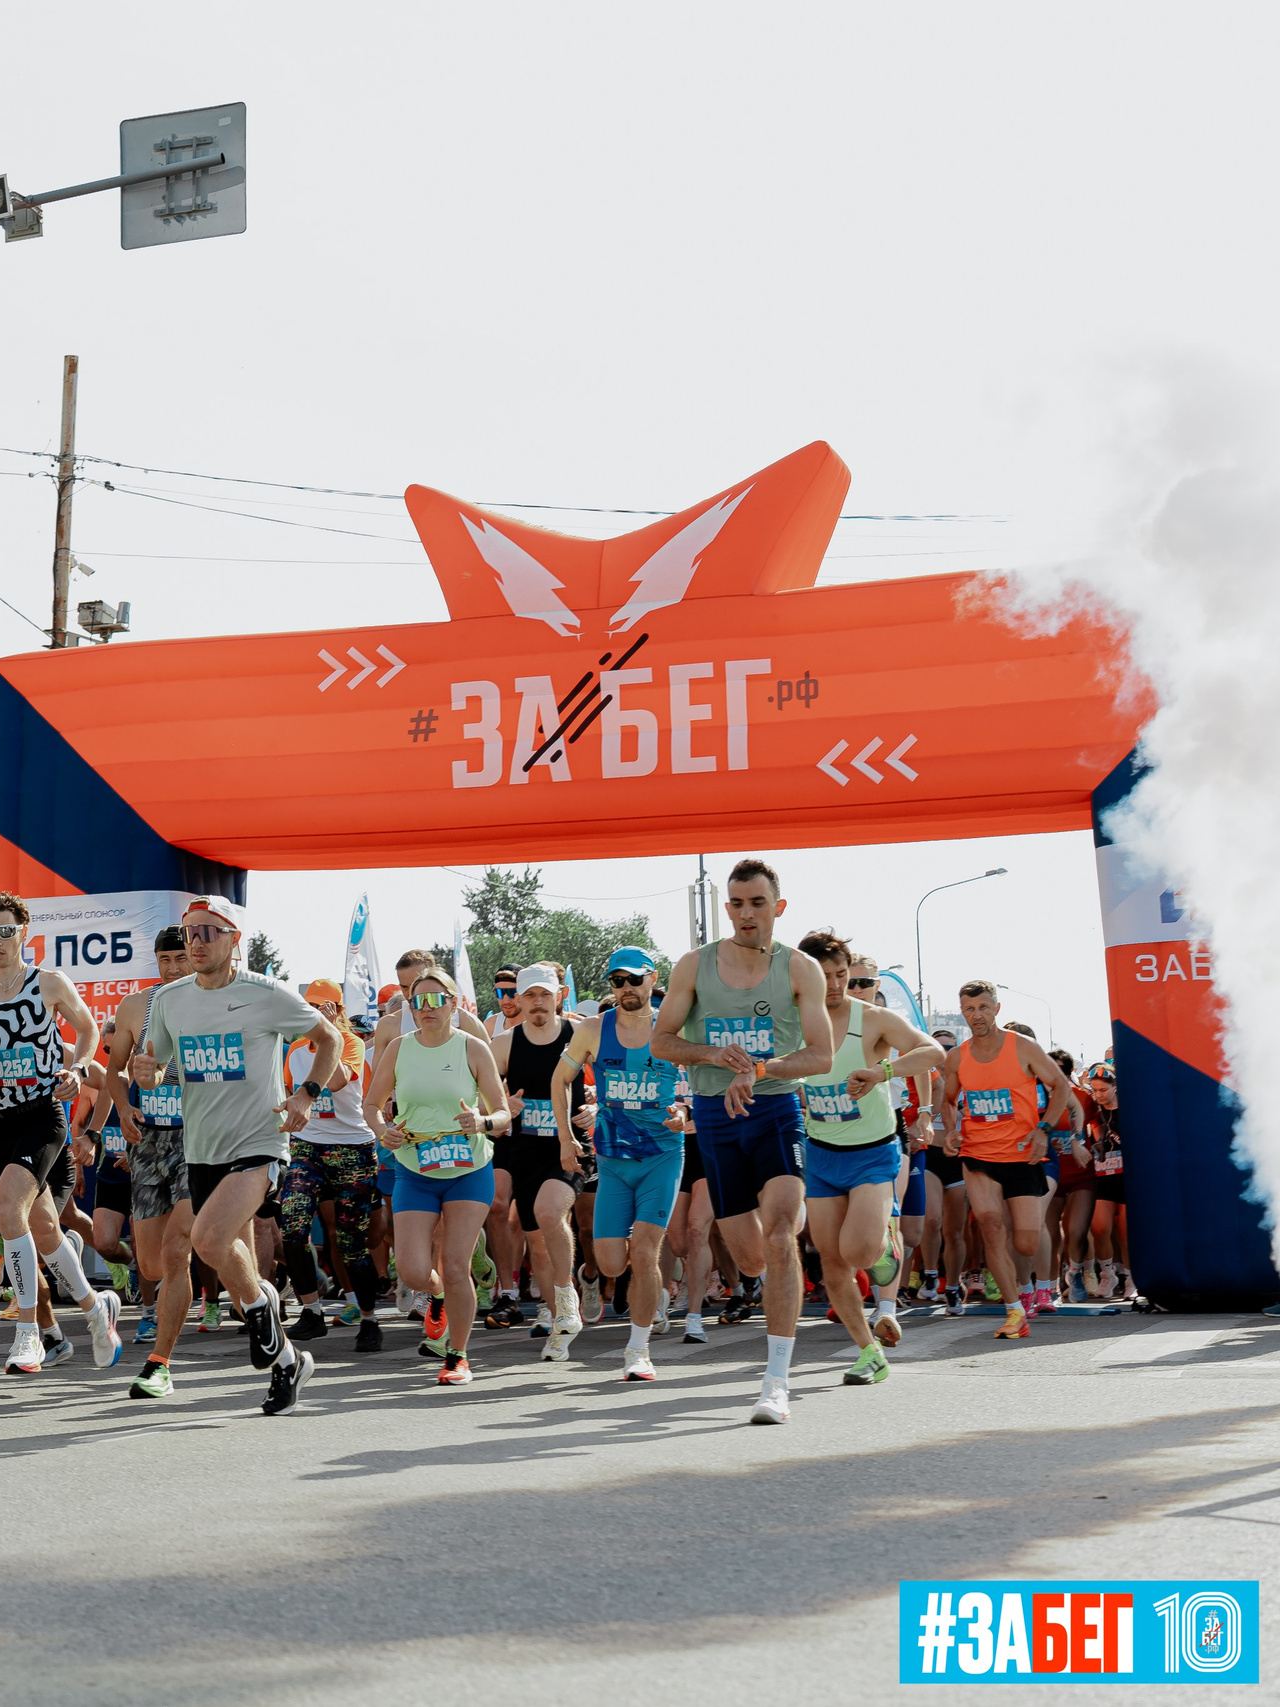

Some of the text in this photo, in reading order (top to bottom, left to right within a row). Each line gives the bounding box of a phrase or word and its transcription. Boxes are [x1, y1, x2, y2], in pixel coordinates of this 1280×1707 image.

[30, 908, 126, 922] ЕНЕРАЛЬНЫЙ СПОНСОР
[55, 931, 134, 967] ПСБ
[1135, 952, 1214, 982] ЗАБ
[709, 1029, 771, 1053] 50058
[183, 1046, 240, 1072] 50345
[202, 1071, 224, 1083] 10KM
[608, 1080, 658, 1100] 50248
[808, 1093, 854, 1115] 50310
[971, 1097, 1008, 1115] 30141
[523, 1109, 558, 1128] 5022
[105, 1134, 127, 1151] 500
[420, 1143, 471, 1165] 30675
